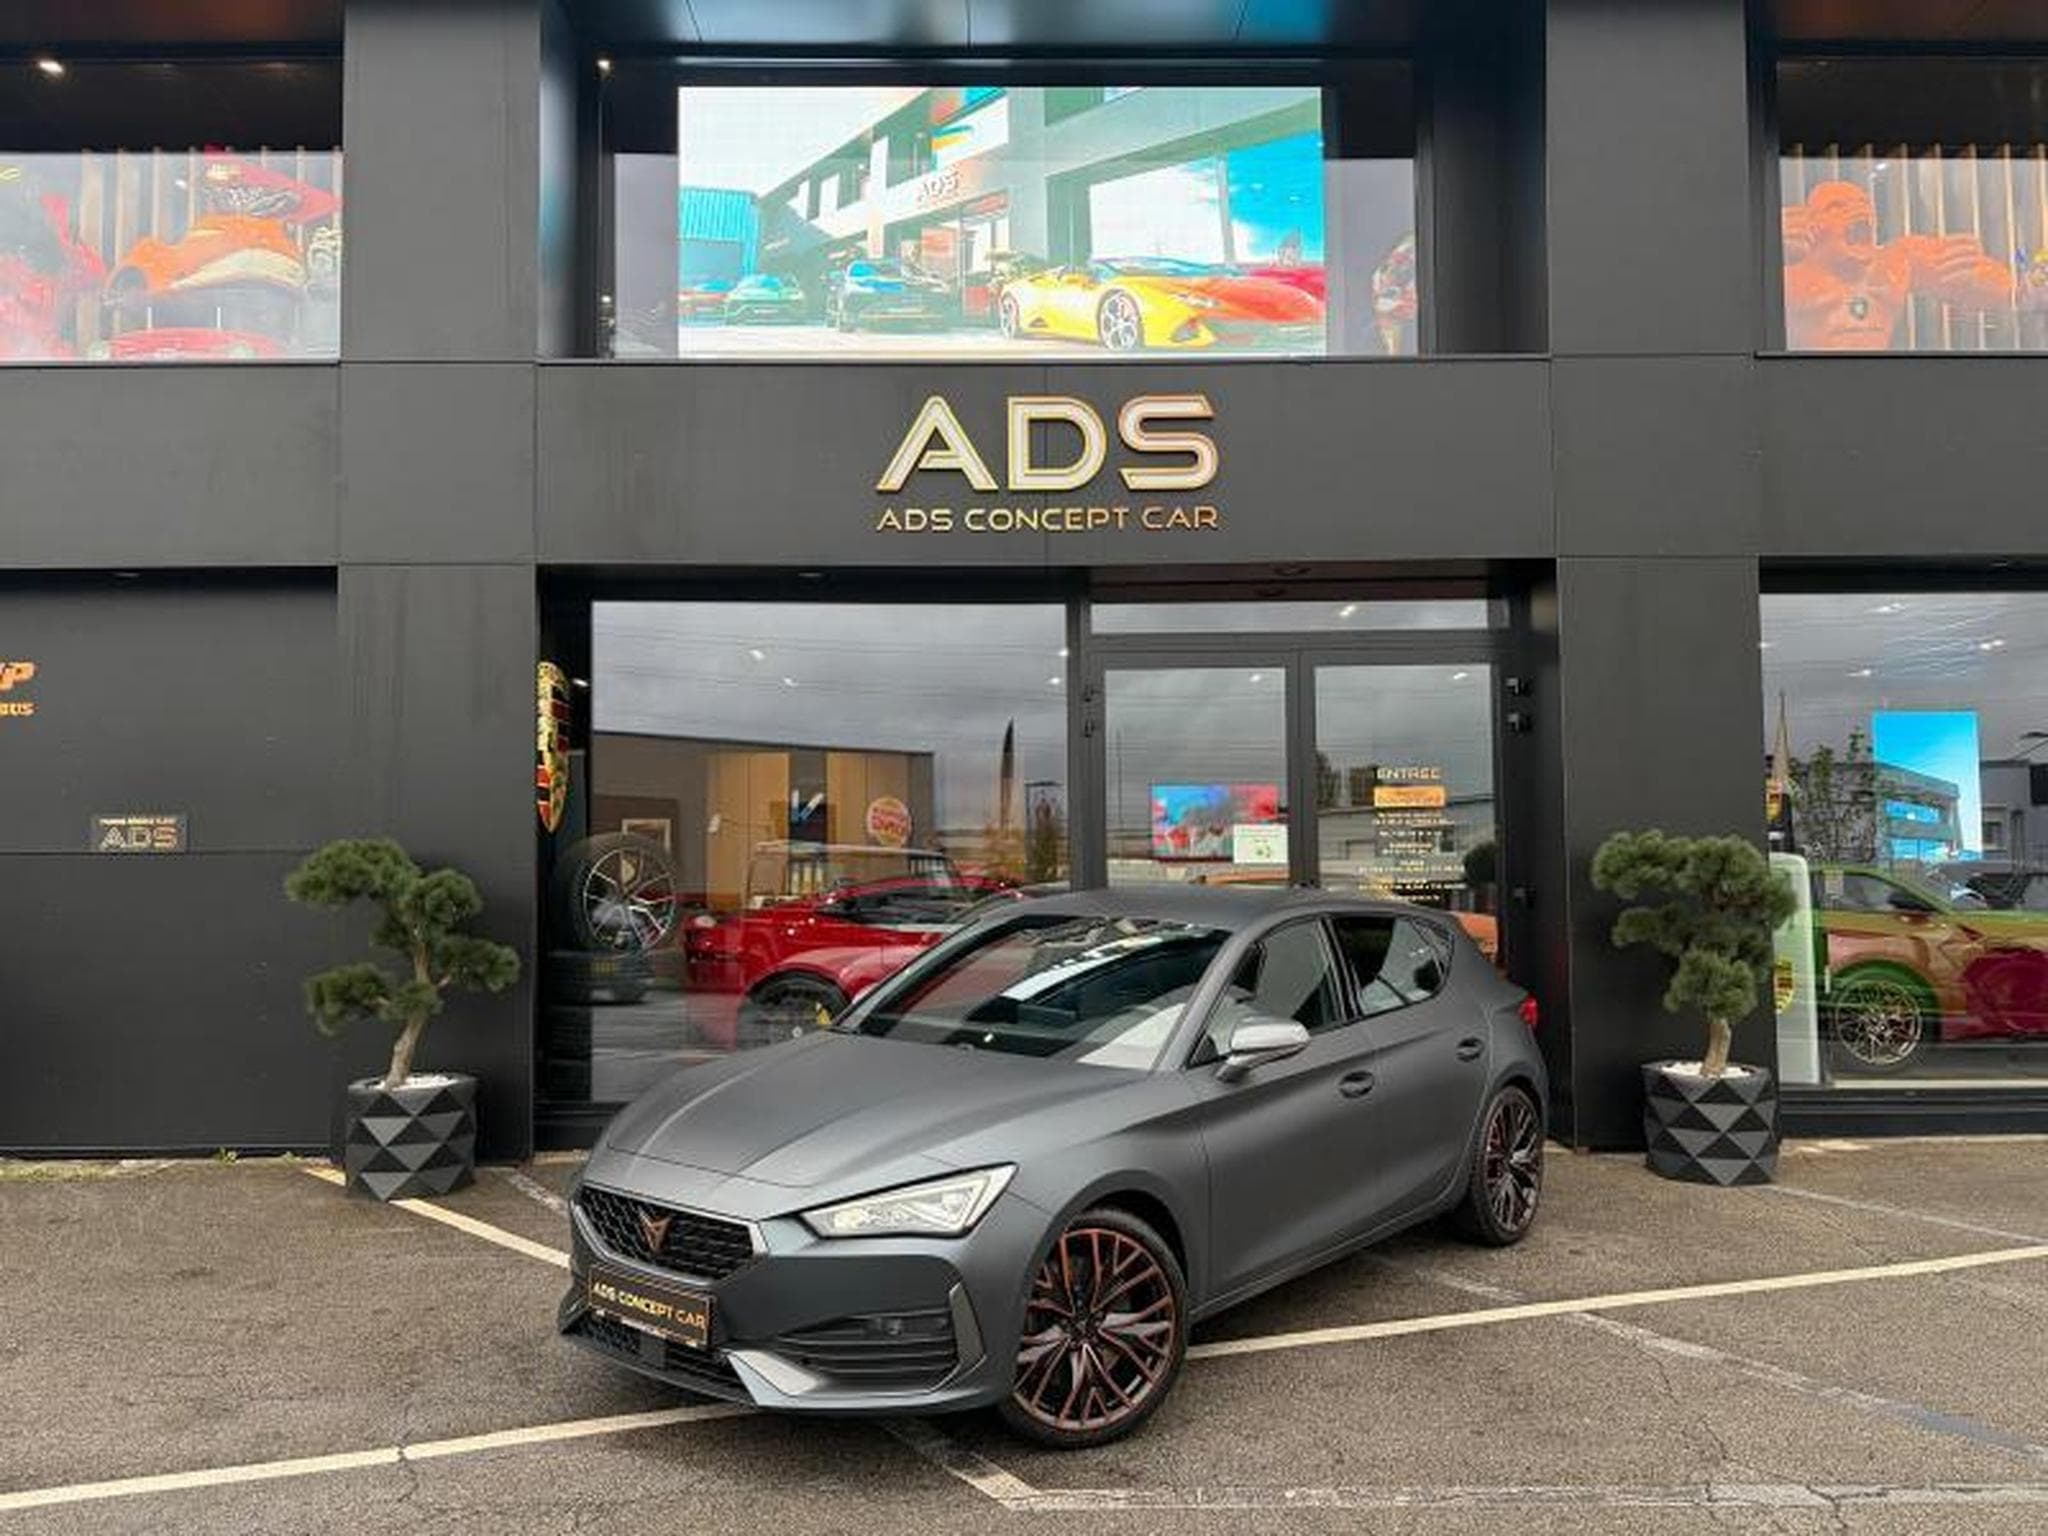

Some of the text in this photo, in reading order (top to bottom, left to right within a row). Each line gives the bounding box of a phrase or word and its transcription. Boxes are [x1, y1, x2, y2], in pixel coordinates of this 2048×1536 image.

[876, 395, 1219, 491] ADS
[876, 505, 1218, 532] ADS CONCEPT CAR
[100, 826, 177, 849] ADS
[619, 1290, 673, 1319] CONCEPT
[676, 1310, 706, 1330] CAR
